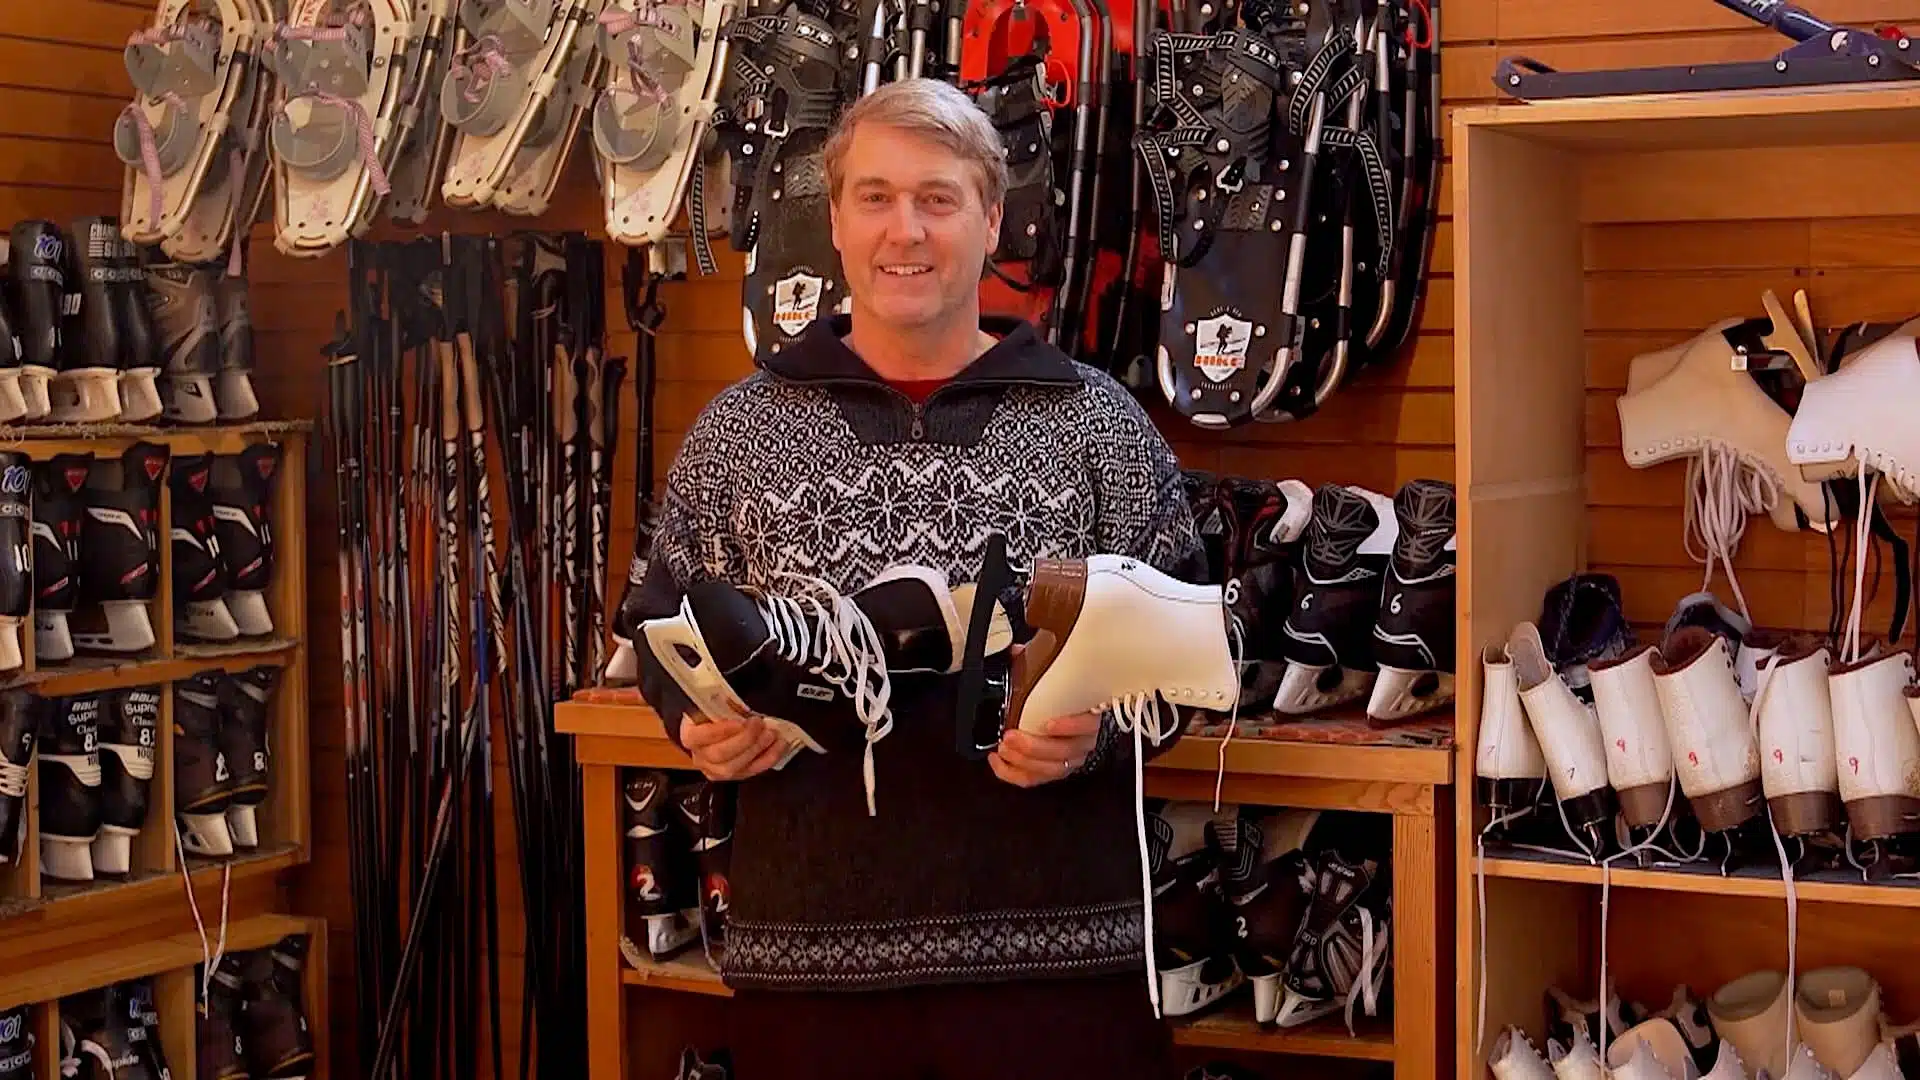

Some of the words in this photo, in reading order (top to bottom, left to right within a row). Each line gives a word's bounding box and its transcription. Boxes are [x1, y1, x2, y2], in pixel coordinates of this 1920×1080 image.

[1224, 577, 1242, 605] 6
[1301, 593, 1314, 611] 6
[1390, 593, 1402, 614] 6
[1616, 737, 1626, 753] 9
[1688, 751, 1699, 767] 9
[1774, 748, 1784, 764] 9
[1848, 756, 1860, 776] 9
[636, 872, 661, 901] 2
[710, 888, 729, 913] 2
